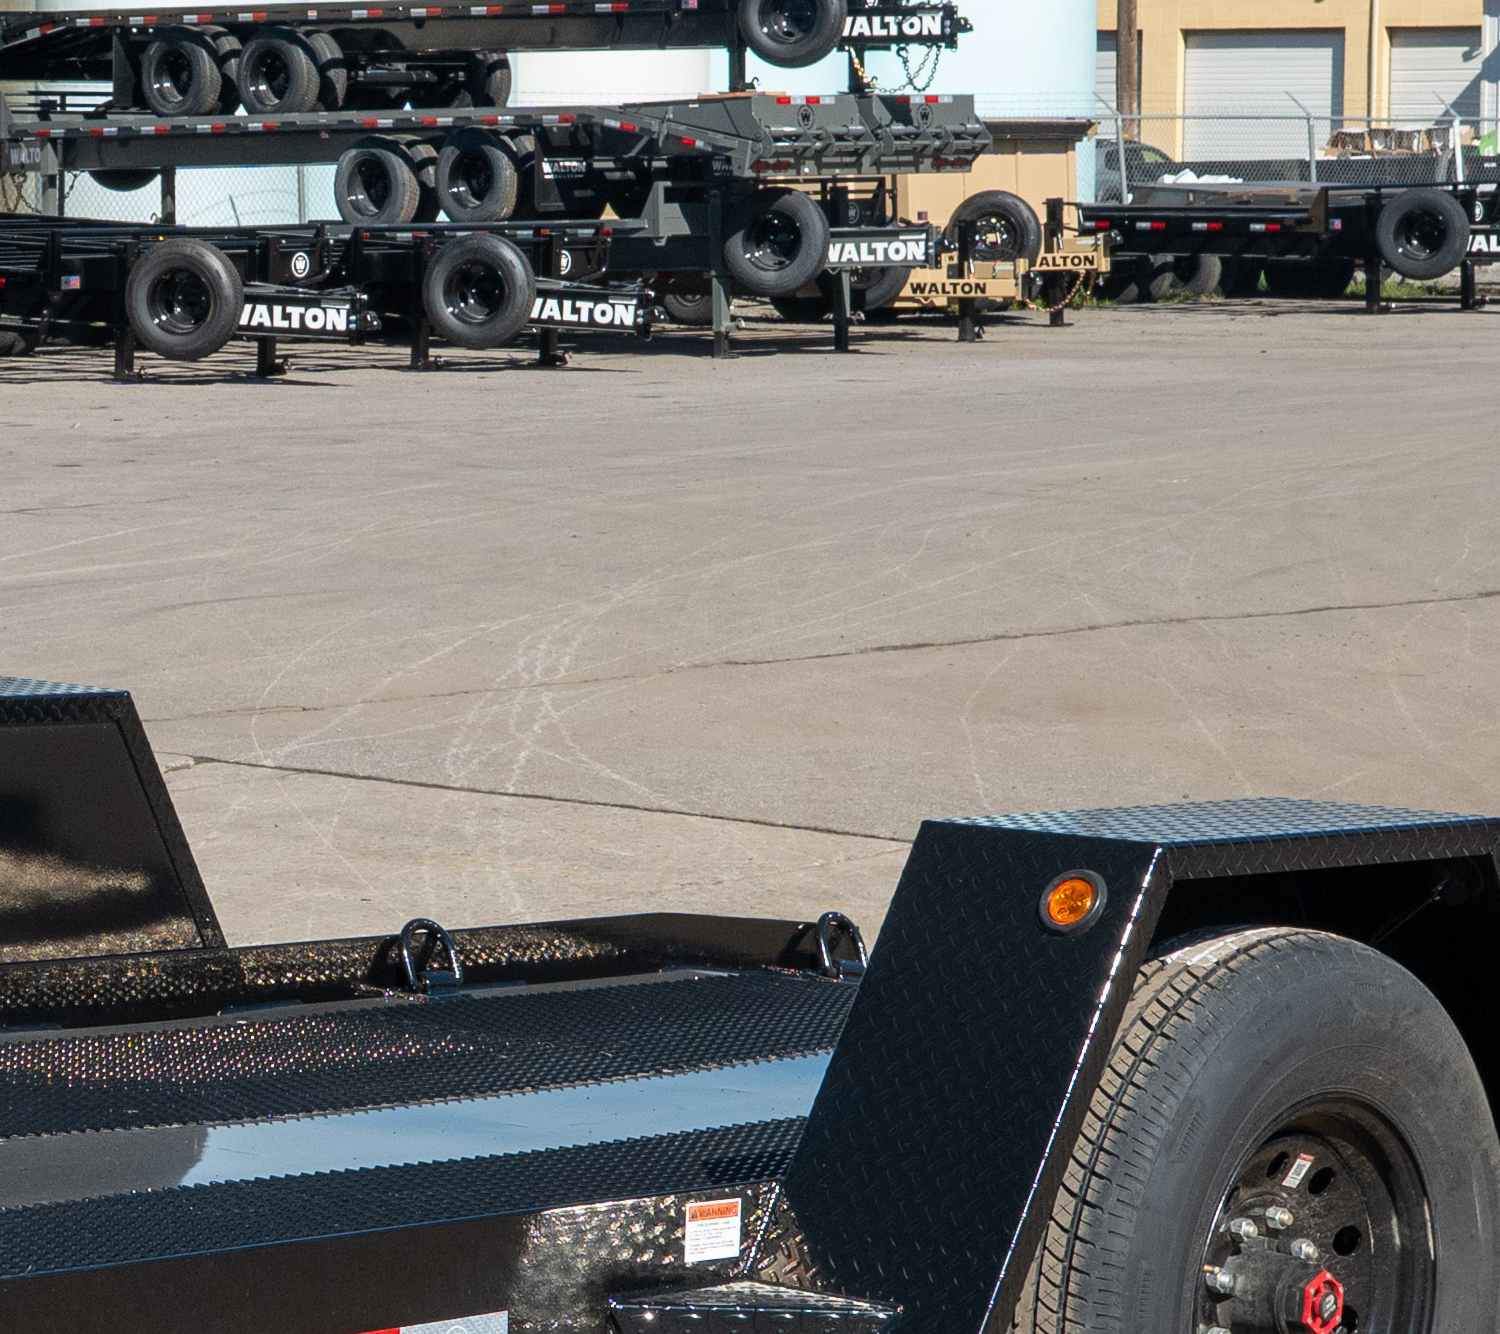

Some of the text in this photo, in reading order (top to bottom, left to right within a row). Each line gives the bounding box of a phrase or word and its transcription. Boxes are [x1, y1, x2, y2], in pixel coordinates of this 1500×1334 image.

[10, 148, 41, 164] WLTO
[541, 161, 586, 173] WALTON
[1039, 254, 1095, 267] ALTON
[910, 282, 986, 296] WALTON
